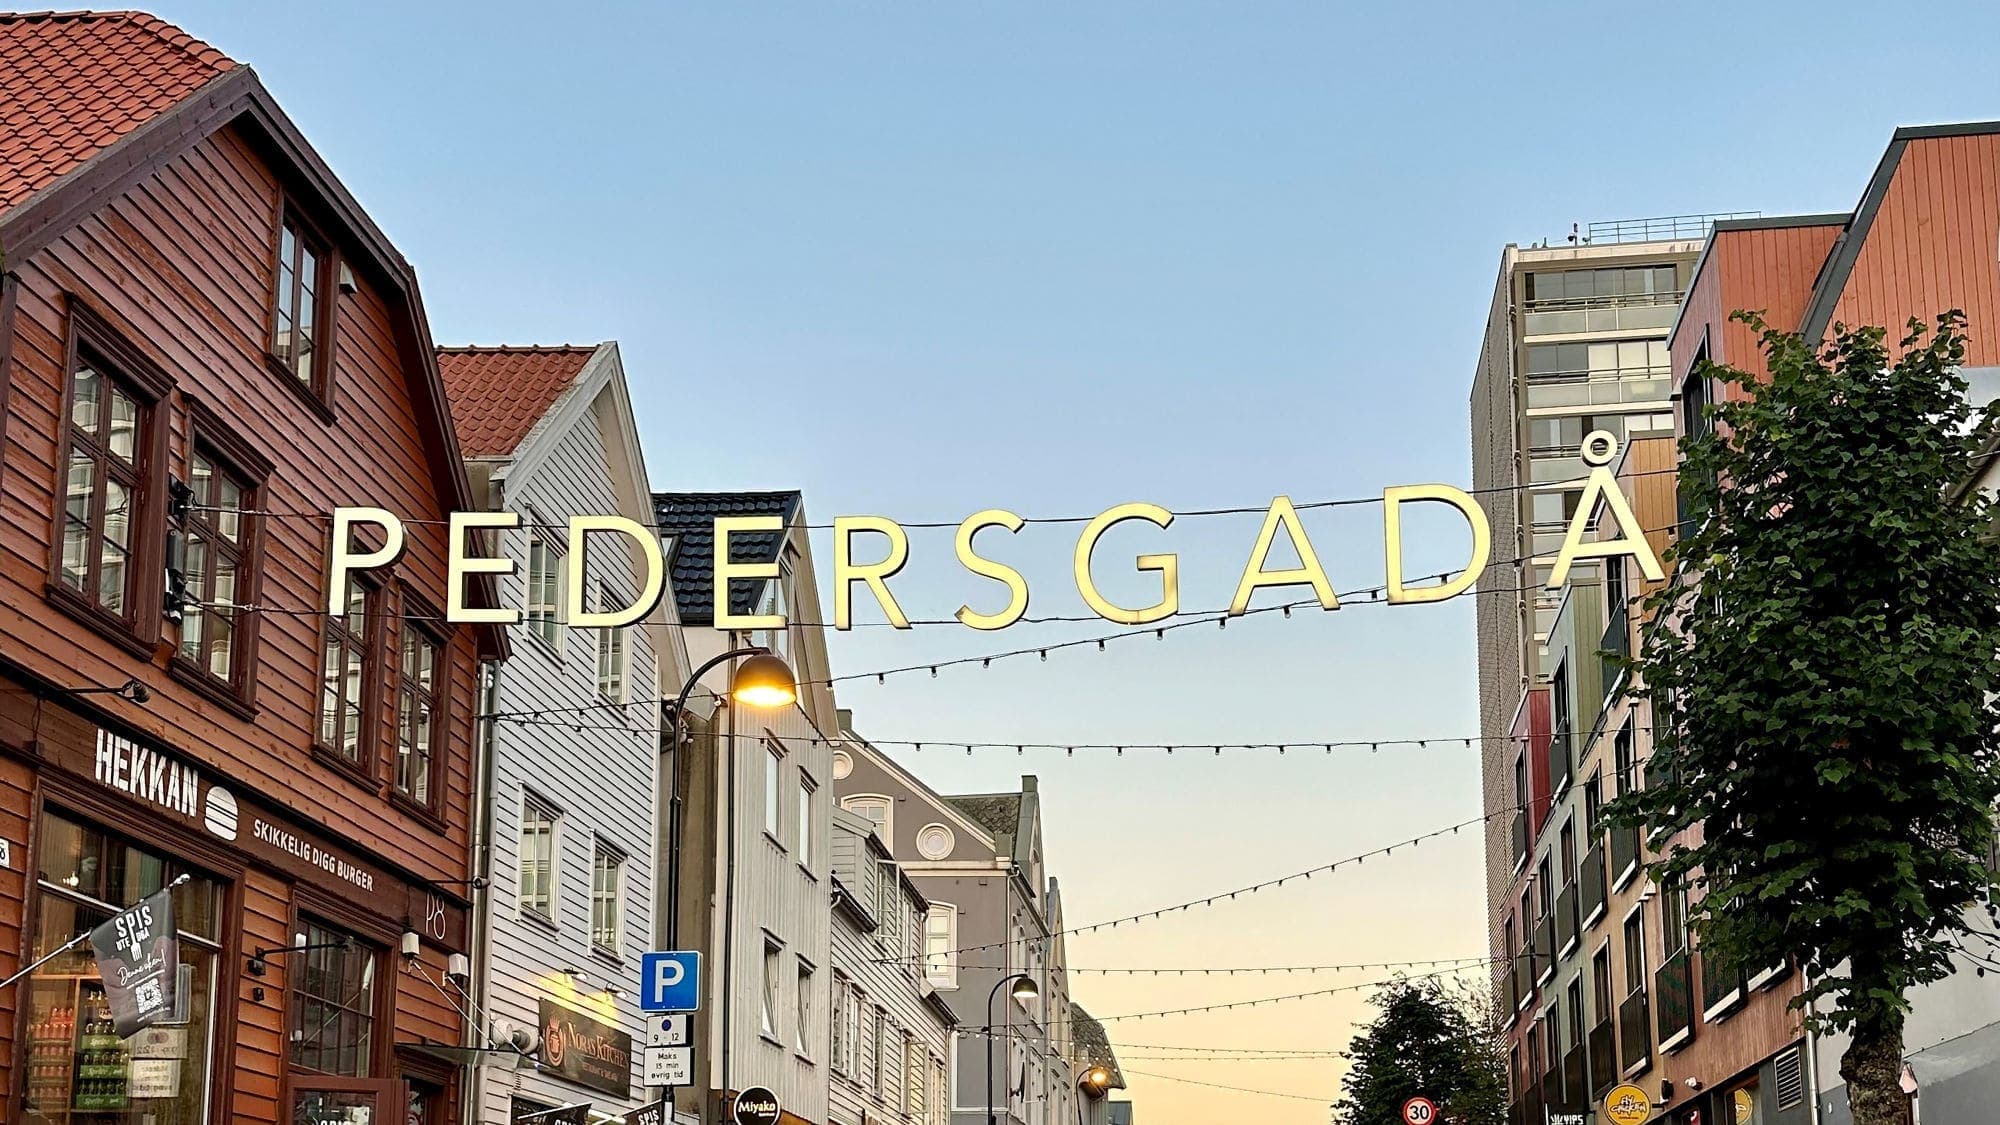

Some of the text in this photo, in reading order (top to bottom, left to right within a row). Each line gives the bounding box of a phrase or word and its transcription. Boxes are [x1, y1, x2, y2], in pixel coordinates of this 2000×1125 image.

[330, 429, 1666, 630] PEDERSGADÅ
[95, 728, 199, 817] HEKKAN
[253, 819, 374, 892] SKIKKELIG DIGG BURGER
[115, 905, 153, 938] SPIS
[426, 890, 446, 940] P8
[116, 937, 131, 951] UTE
[655, 959, 685, 1003] P
[653, 1034, 659, 1043] 9
[671, 1032, 680, 1041] 12
[657, 1052, 677, 1060] Maks
[656, 1061, 679, 1070] 15 min
[651, 1070, 684, 1083] øvrig tid
[738, 1100, 776, 1114] Miyako
[1409, 1105, 1430, 1120] 30
[638, 1109, 660, 1125] SPIS
